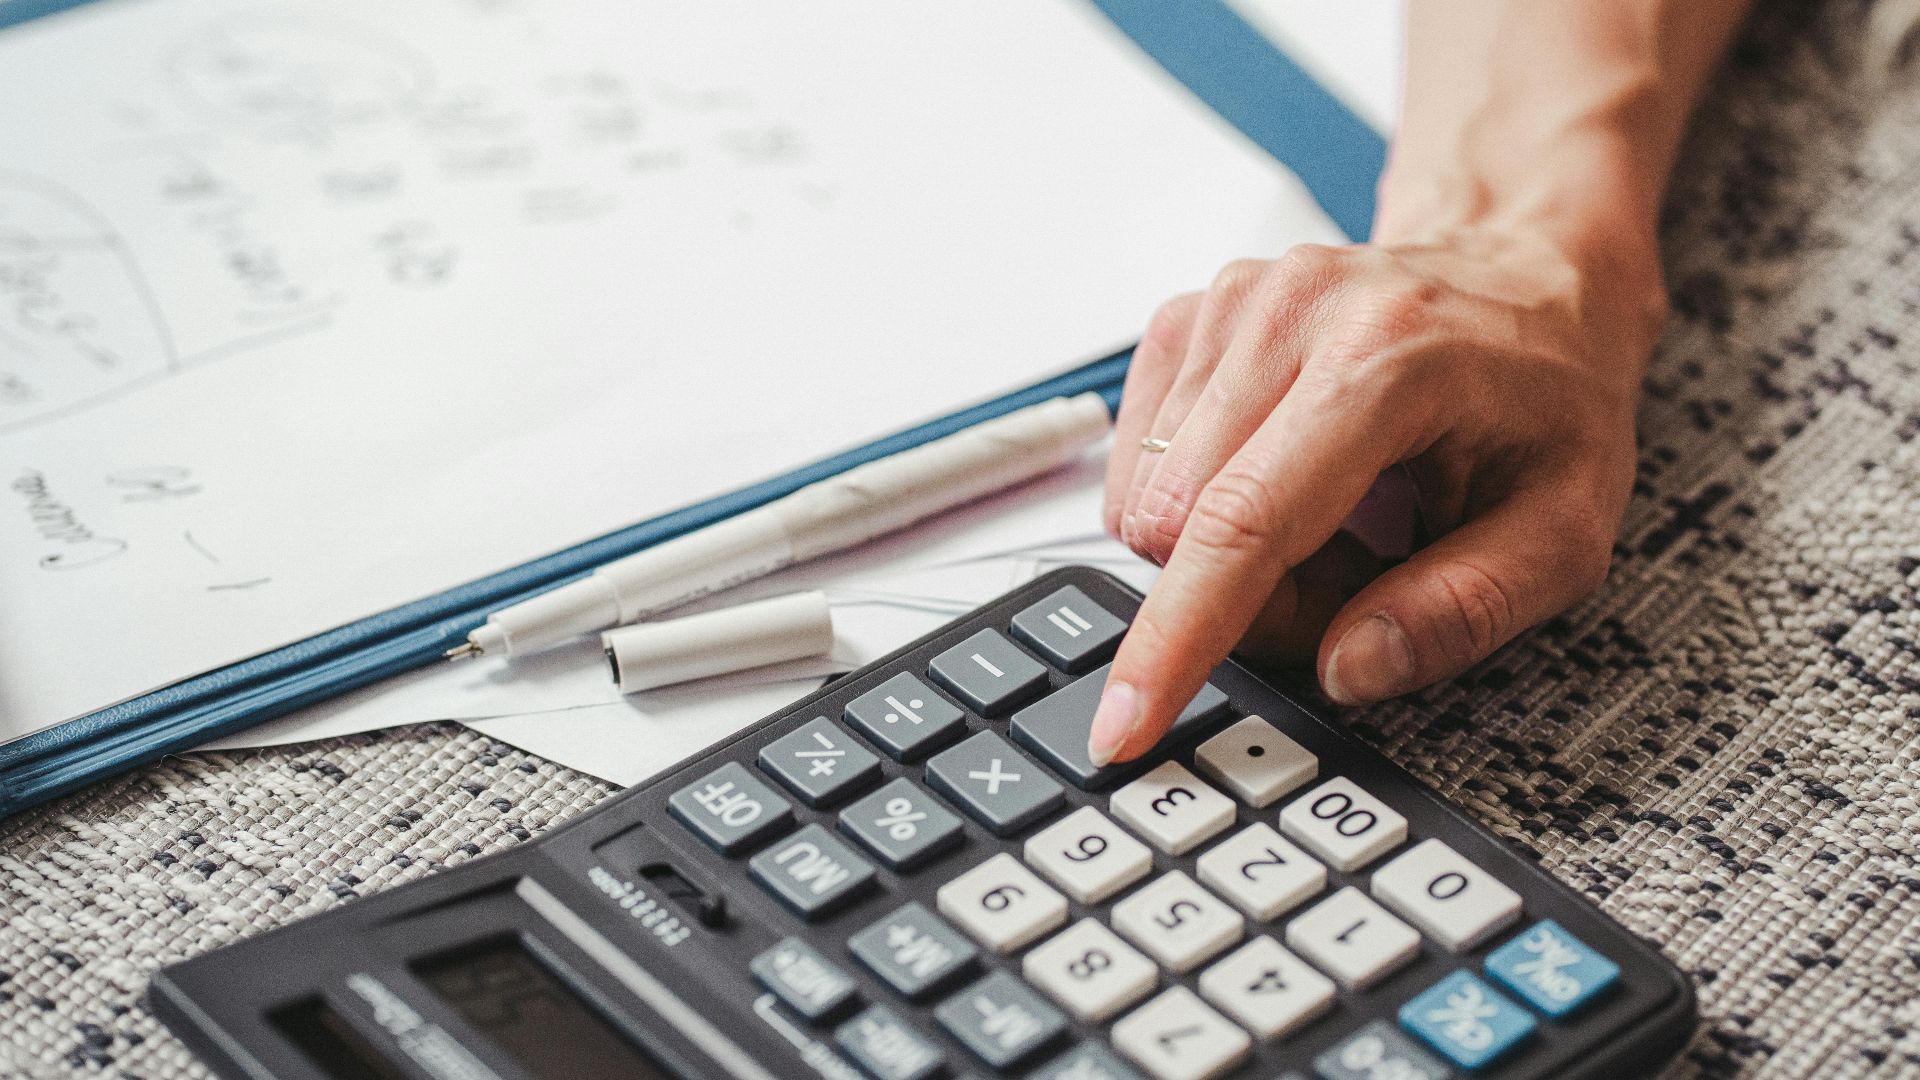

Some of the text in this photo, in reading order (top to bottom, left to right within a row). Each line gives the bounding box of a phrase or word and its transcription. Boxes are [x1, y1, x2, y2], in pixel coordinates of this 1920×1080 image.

[692, 781, 763, 827] OFF
[1151, 787, 1196, 816] 3
[1310, 792, 1378, 837] 00
[875, 798, 927, 841] %
[774, 841, 850, 895] MU
[1241, 849, 1287, 881] 2
[1427, 872, 1469, 900] 0
[1154, 901, 1201, 930] 5
[1334, 920, 1367, 944] 1
[887, 925, 951, 978] M+
[1068, 950, 1113, 979] 8
[1246, 969, 1287, 993] 4
[1157, 1025, 1205, 1055] 7
